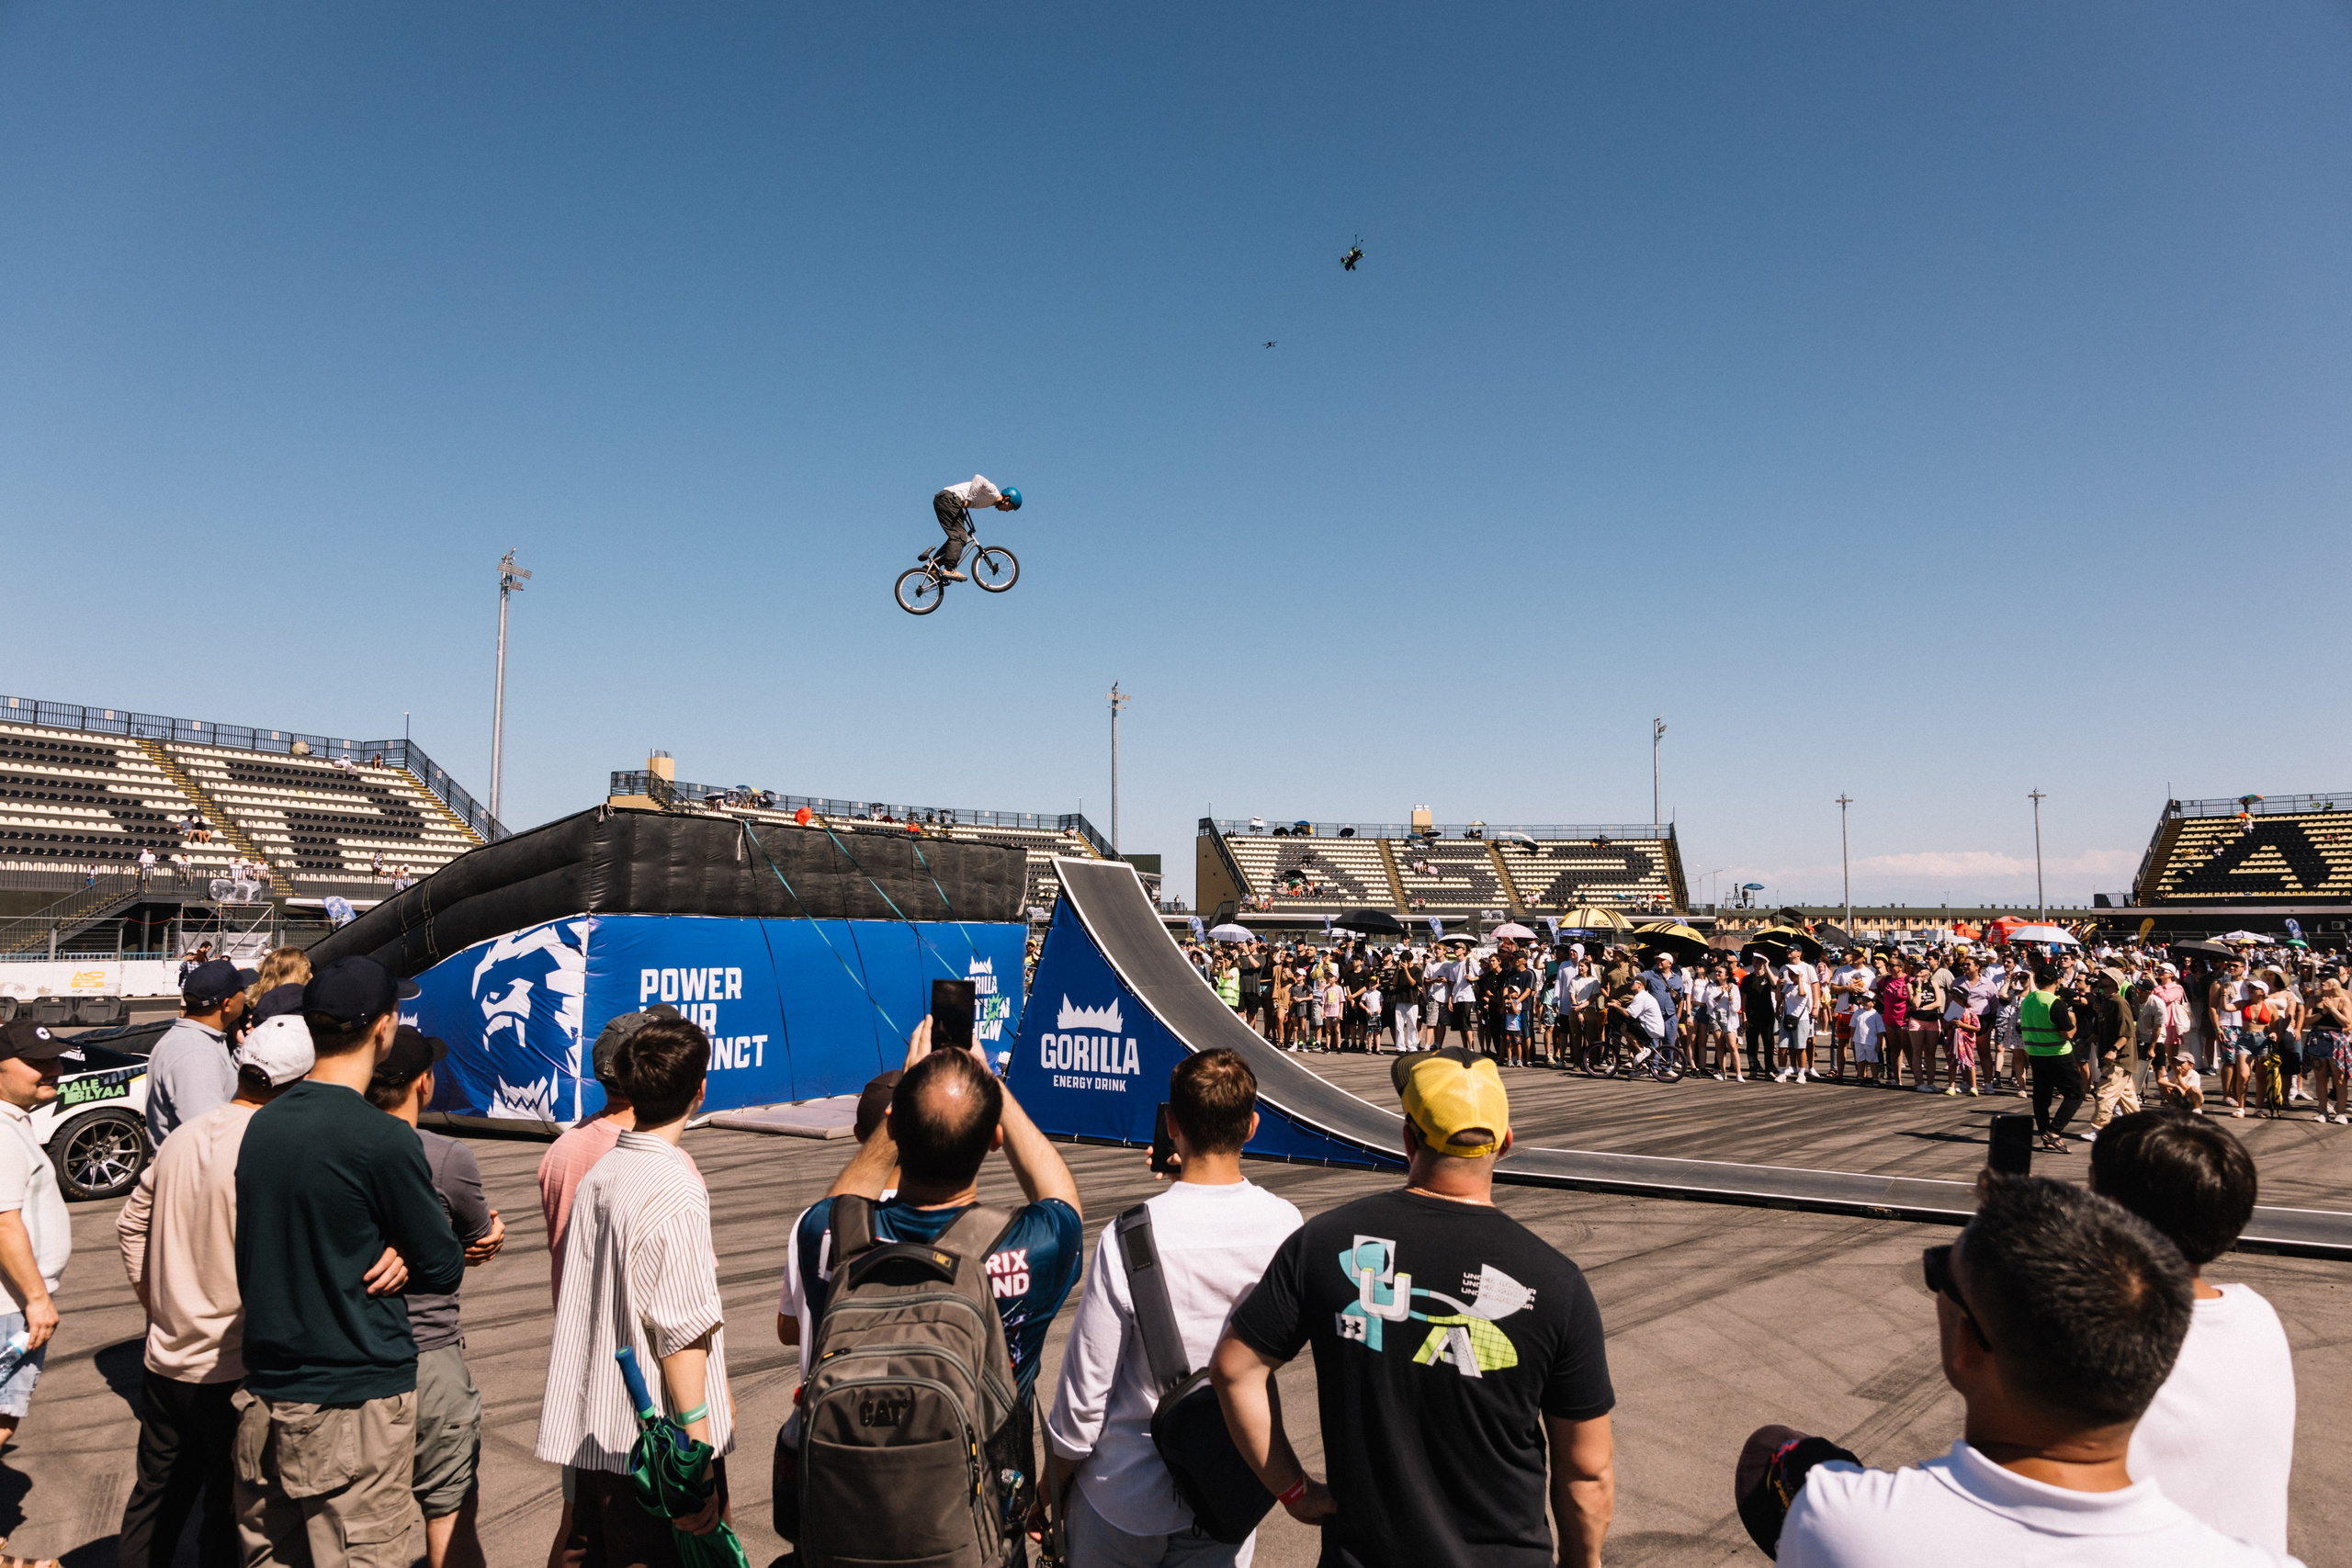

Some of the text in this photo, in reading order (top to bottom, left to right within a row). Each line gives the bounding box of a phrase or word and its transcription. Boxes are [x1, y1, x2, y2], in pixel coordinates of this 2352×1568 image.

[72, 971, 106, 981] ASP
[639, 967, 742, 1003] POWER
[964, 976, 998, 995] RILLA
[639, 1003, 718, 1035] UR
[250, 1054, 269, 1066] PRADA
[1040, 1033, 1140, 1075] GORILLA
[56, 1078, 99, 1095] AALE
[1053, 1075, 1126, 1092] ENERGY DRINK
[985, 1249, 1029, 1275] RIX
[991, 1272, 1030, 1298] ND
[859, 1399, 900, 1427] CAT
